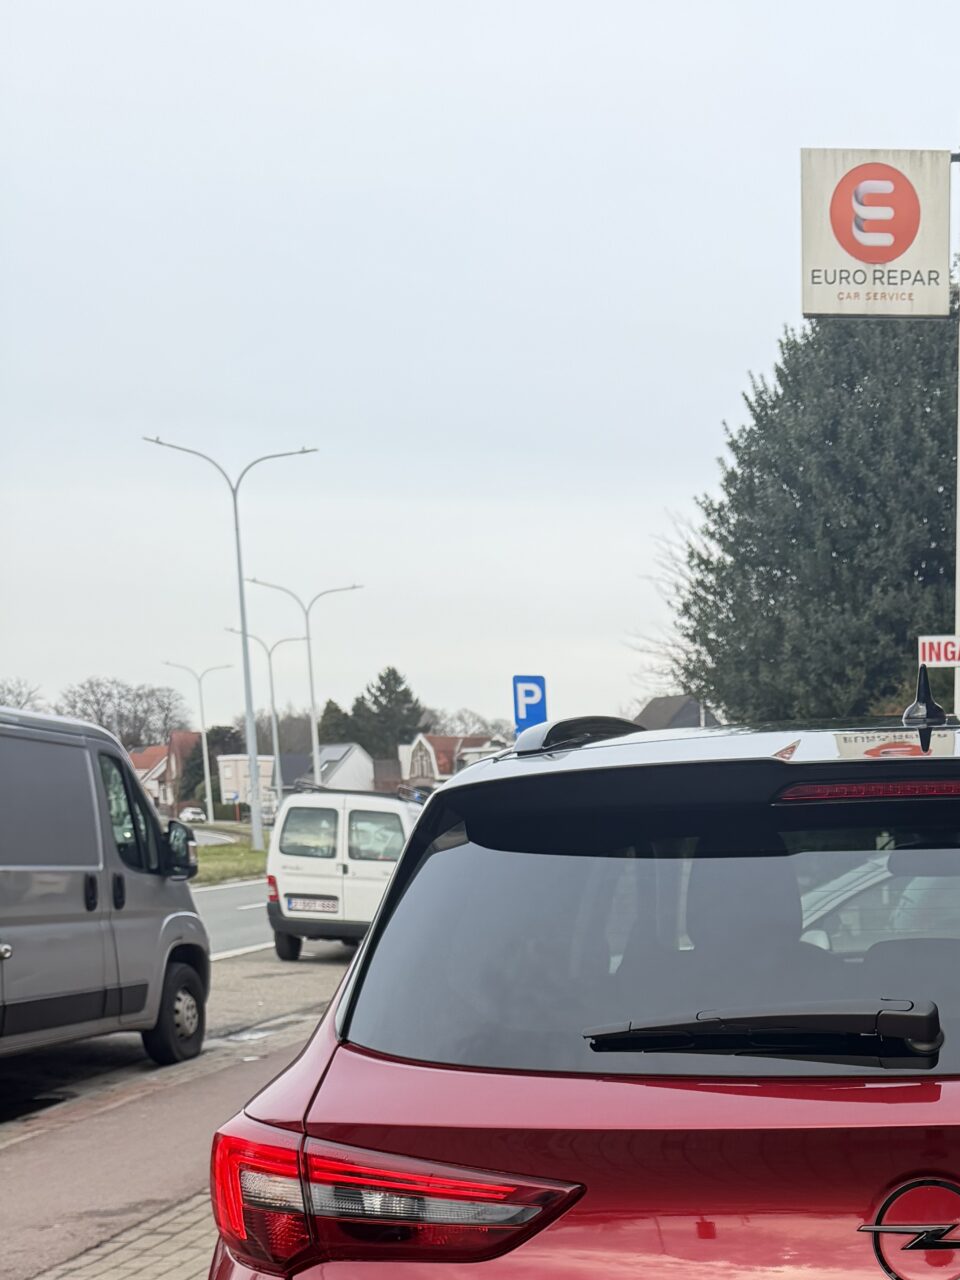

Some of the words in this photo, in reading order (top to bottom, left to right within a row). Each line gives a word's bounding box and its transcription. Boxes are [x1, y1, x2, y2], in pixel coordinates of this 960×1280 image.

[810, 269, 867, 285] EURO
[873, 269, 940, 286] REPAR
[837, 292, 861, 301] CAR
[865, 291, 914, 301] SERVICE
[517, 683, 542, 719] P
